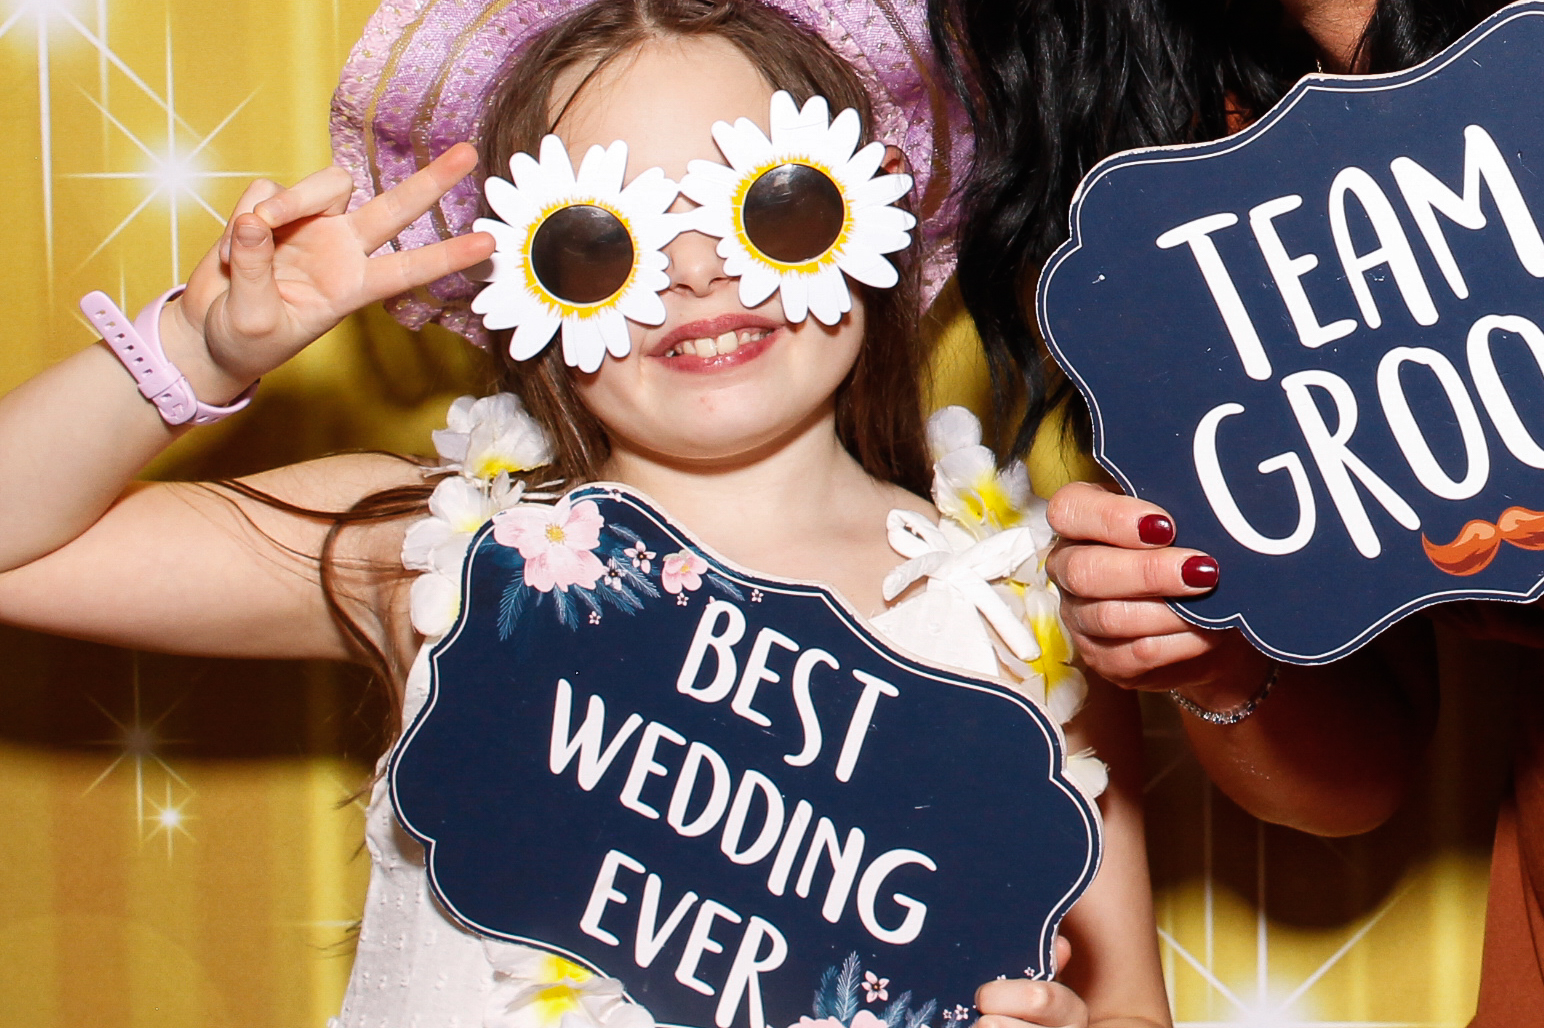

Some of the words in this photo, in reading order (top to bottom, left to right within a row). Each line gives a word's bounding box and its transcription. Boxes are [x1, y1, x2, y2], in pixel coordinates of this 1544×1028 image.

[676, 599, 900, 783] BEST
[549, 678, 937, 945] WEDDING
[579, 849, 788, 1028] EVER
